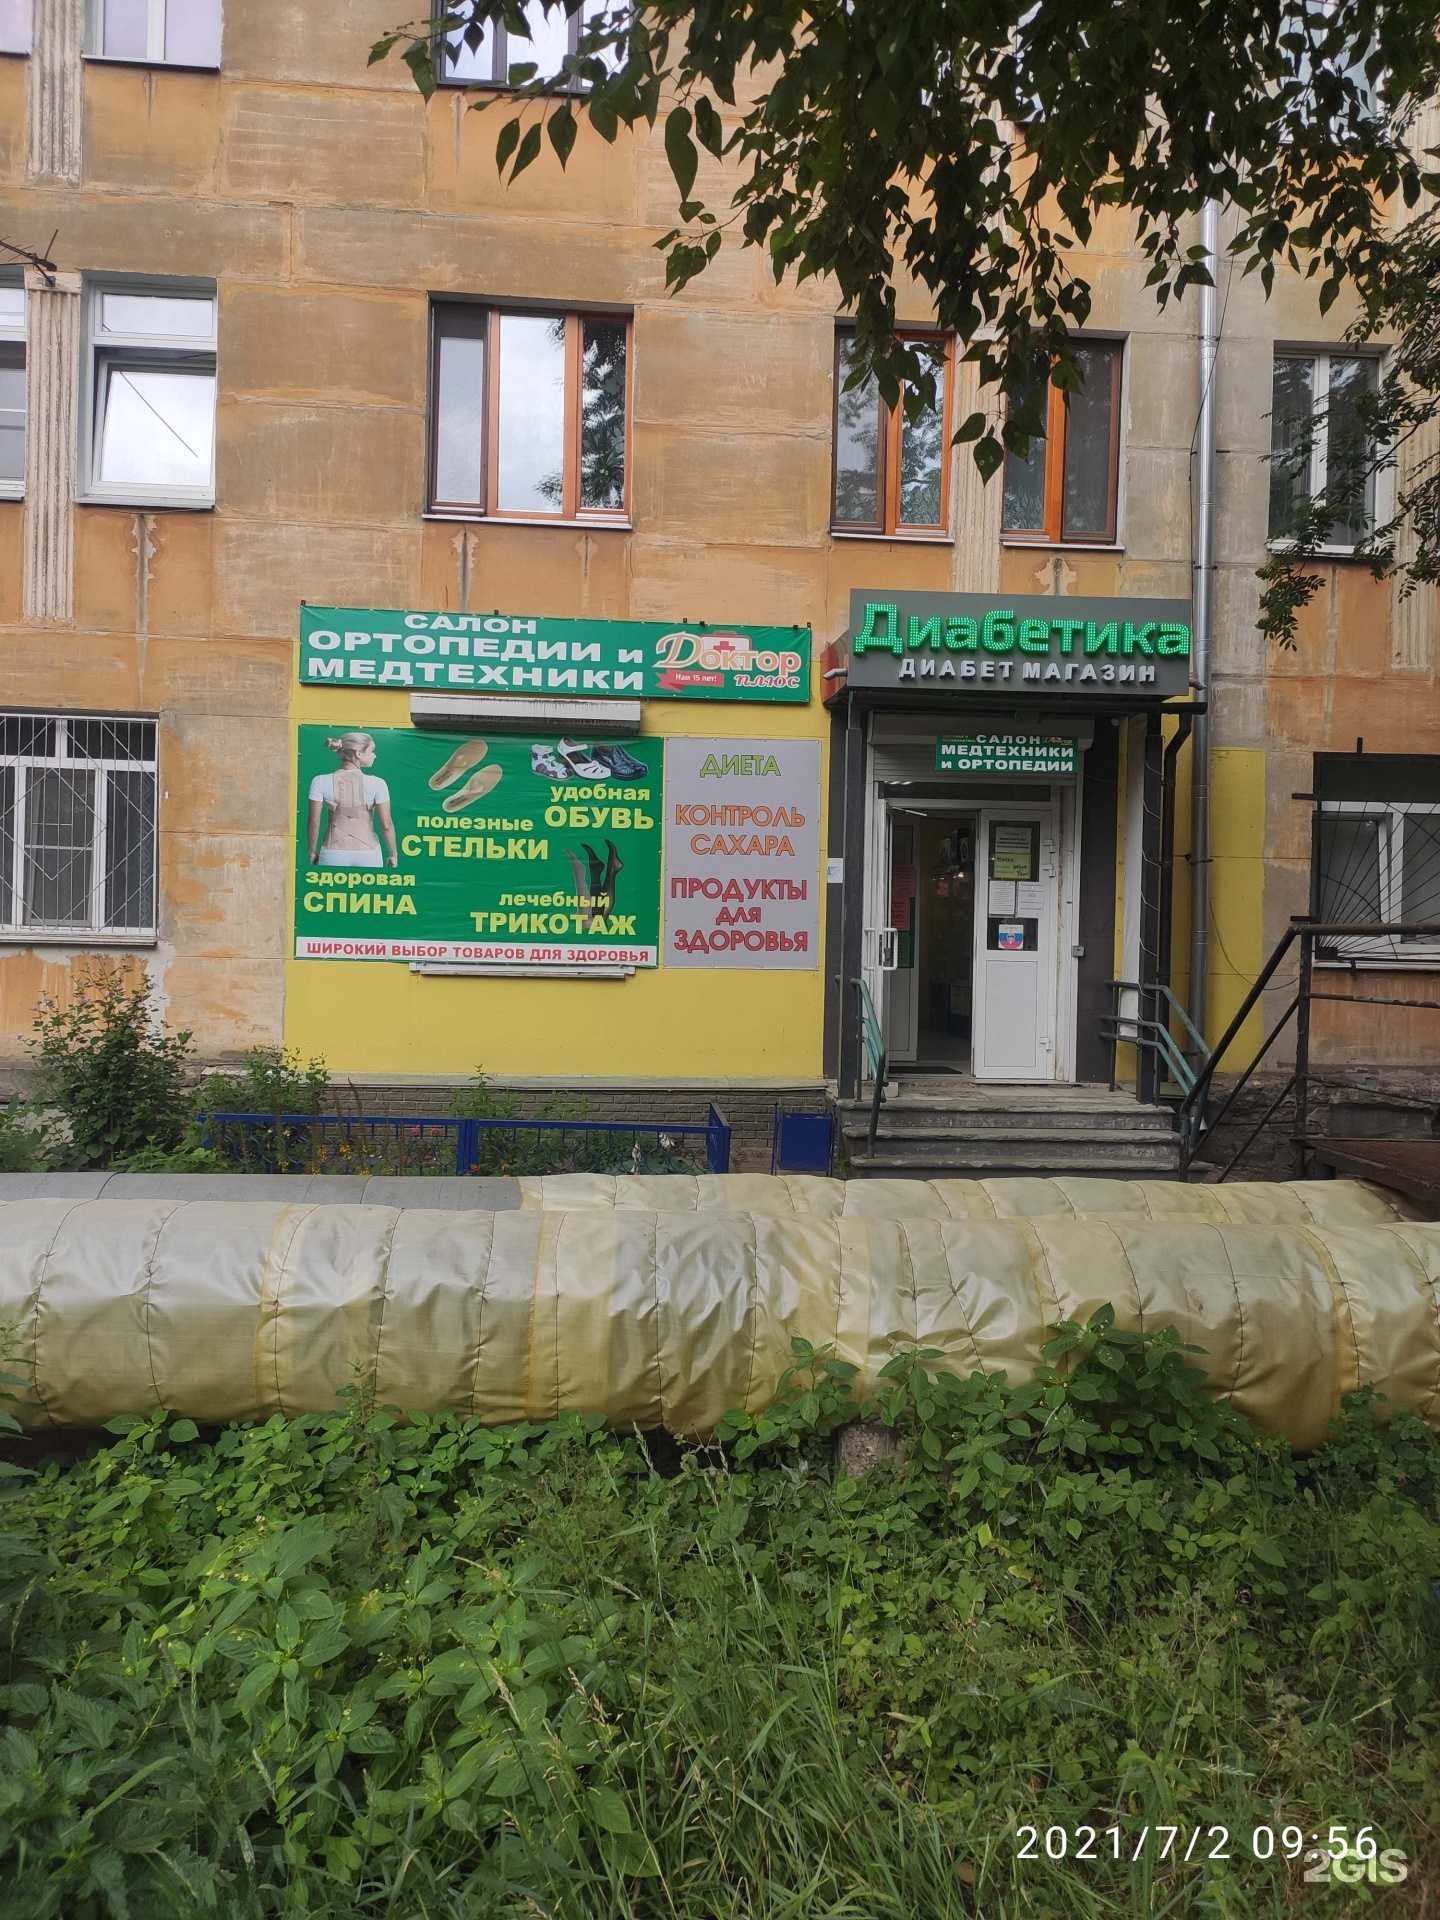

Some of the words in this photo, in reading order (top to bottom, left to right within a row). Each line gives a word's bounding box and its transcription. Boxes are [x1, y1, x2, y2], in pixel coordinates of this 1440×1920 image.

[404, 615, 537, 635] САЛОН
[853, 602, 1191, 657] Диабетика
[308, 631, 601, 662] ОРТОПЕДИИ
[618, 648, 643, 663] и
[652, 631, 802, 676] Доктор
[307, 658, 644, 690] МЕДТЕХНИКИ
[693, 674, 700, 682] 15
[898, 658, 1014, 682] ДИАБЕТ
[1021, 661, 1156, 684] МАГАЗИН
[976, 735, 1040, 744] САЛОН
[941, 745, 1074, 758] МЕДТЕХНИКИ
[699, 754, 781, 778] ДИЕТА
[941, 760, 952, 769] и
[958, 759, 1073, 772] ОРТОПЕДИИ
[550, 783, 650, 803] удобная
[416, 816, 534, 831] полезные
[544, 806, 654, 830] ОБУВЬ
[675, 804, 806, 827] КОНТРОЛЬ
[401, 835, 549, 860] СТЕЛЬКИ
[690, 834, 796, 856] САХАРА
[305, 870, 416, 889] здоровая
[671, 877, 808, 903] ПРОДУКТЫ
[303, 892, 417, 915] СПИНА
[499, 891, 610, 909] лечебный
[470, 912, 637, 936] ТРИКОТАЖ
[715, 907, 762, 926] ДЛЯ
[306, 942, 387, 956] ШИРОКИЙ
[391, 945, 447, 957] ВЫБОР
[454, 947, 525, 960] ТОВАРОВ
[530, 949, 562, 962] ДЛЯ
[567, 949, 649, 963] ЗДОРОВЬЯ
[674, 929, 808, 954] ЗДОРОВЬЯ
